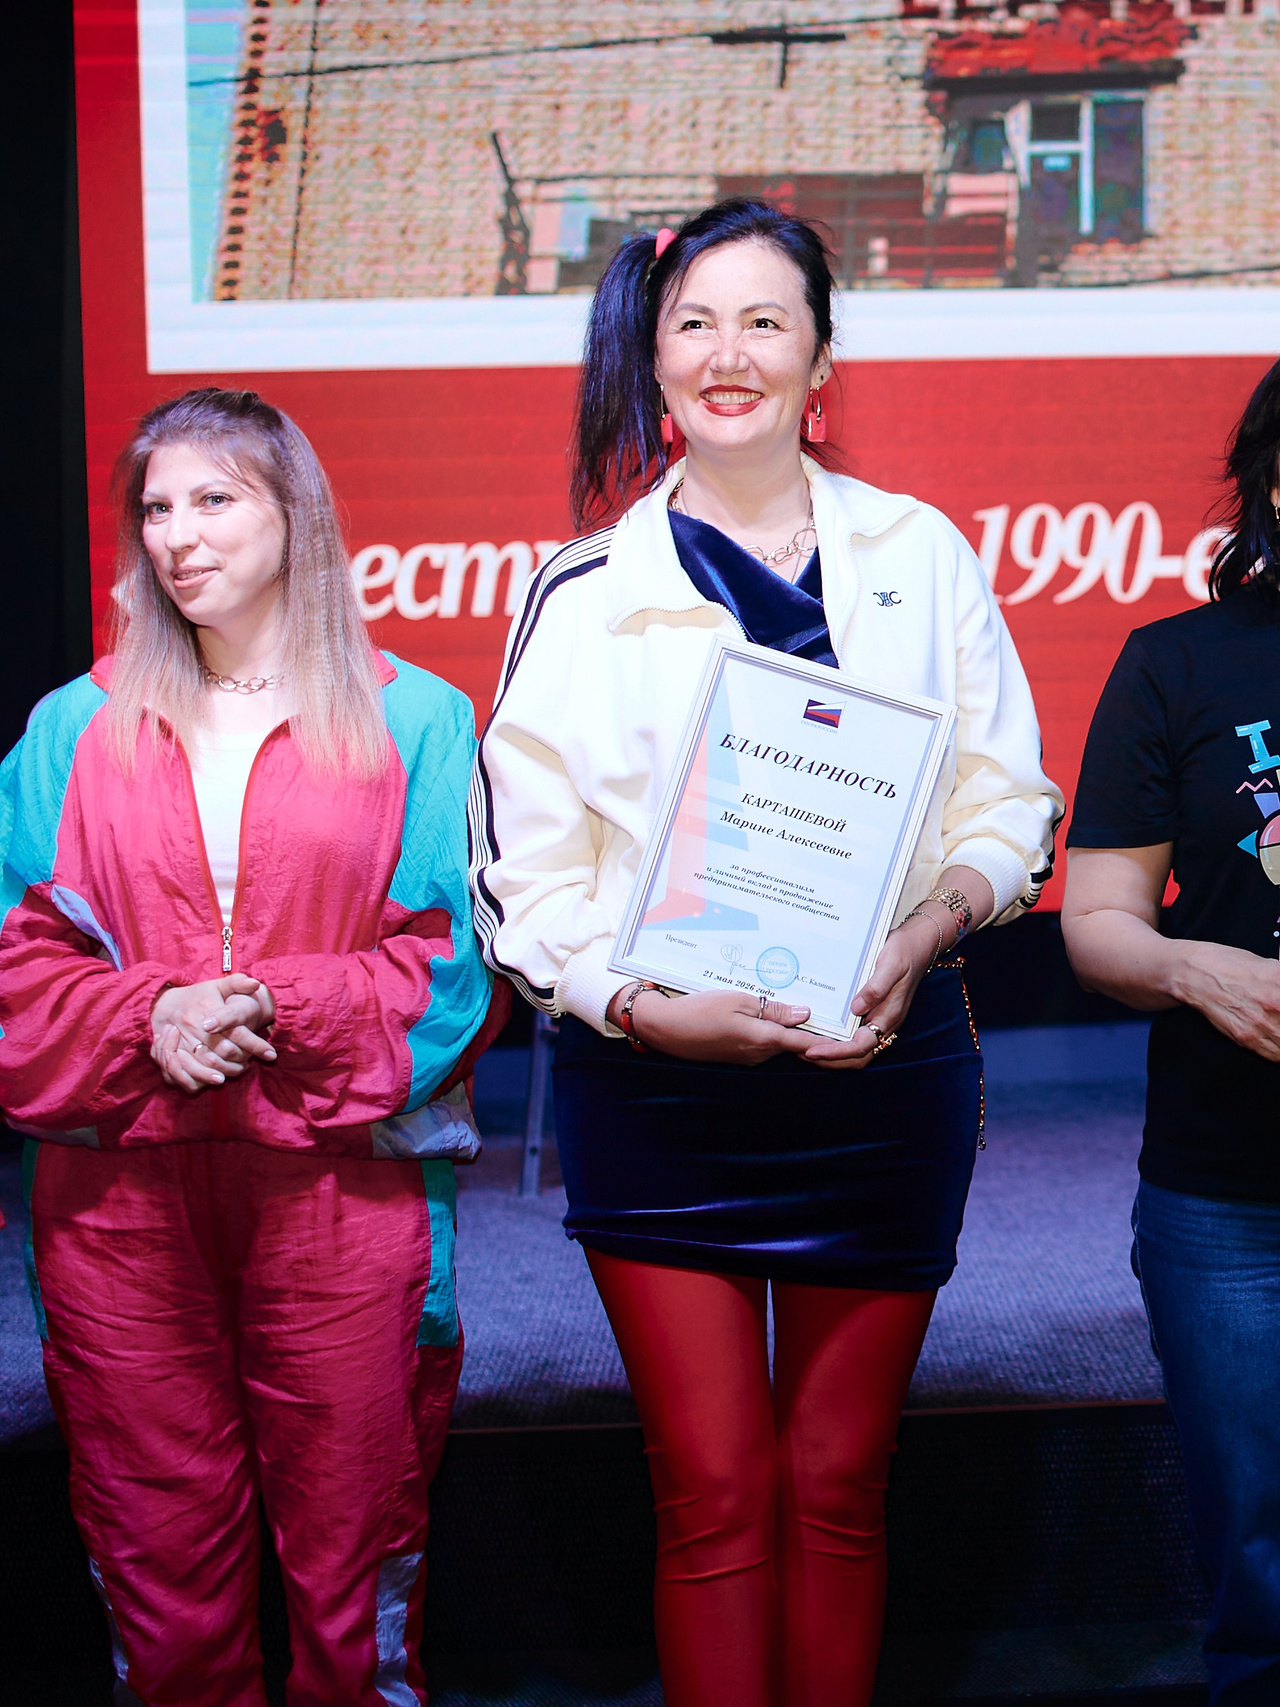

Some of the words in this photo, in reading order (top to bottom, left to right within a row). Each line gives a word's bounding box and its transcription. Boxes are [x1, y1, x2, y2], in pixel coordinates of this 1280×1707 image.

[719, 733, 897, 799] БЛАГОДАРНОСТЬ
[741, 793, 848, 833] КАРТАШЕВОЙ
[720, 810, 774, 835] Марине
[775, 828, 853, 860] Алексеевне
[693, 872, 791, 906] предпринимательского
[791, 902, 840, 922] сообщества
[713, 868, 746, 883] личный
[747, 878, 772, 891] вклад
[779, 887, 834, 909] продвижение
[730, 863, 740, 871] за
[741, 867, 815, 894] профессионализм
[665, 933, 698, 949] Президент
[702, 970, 712, 979] 21
[713, 975, 733, 985] мая
[735, 979, 755, 991] 2026
[755, 986, 776, 998] года
